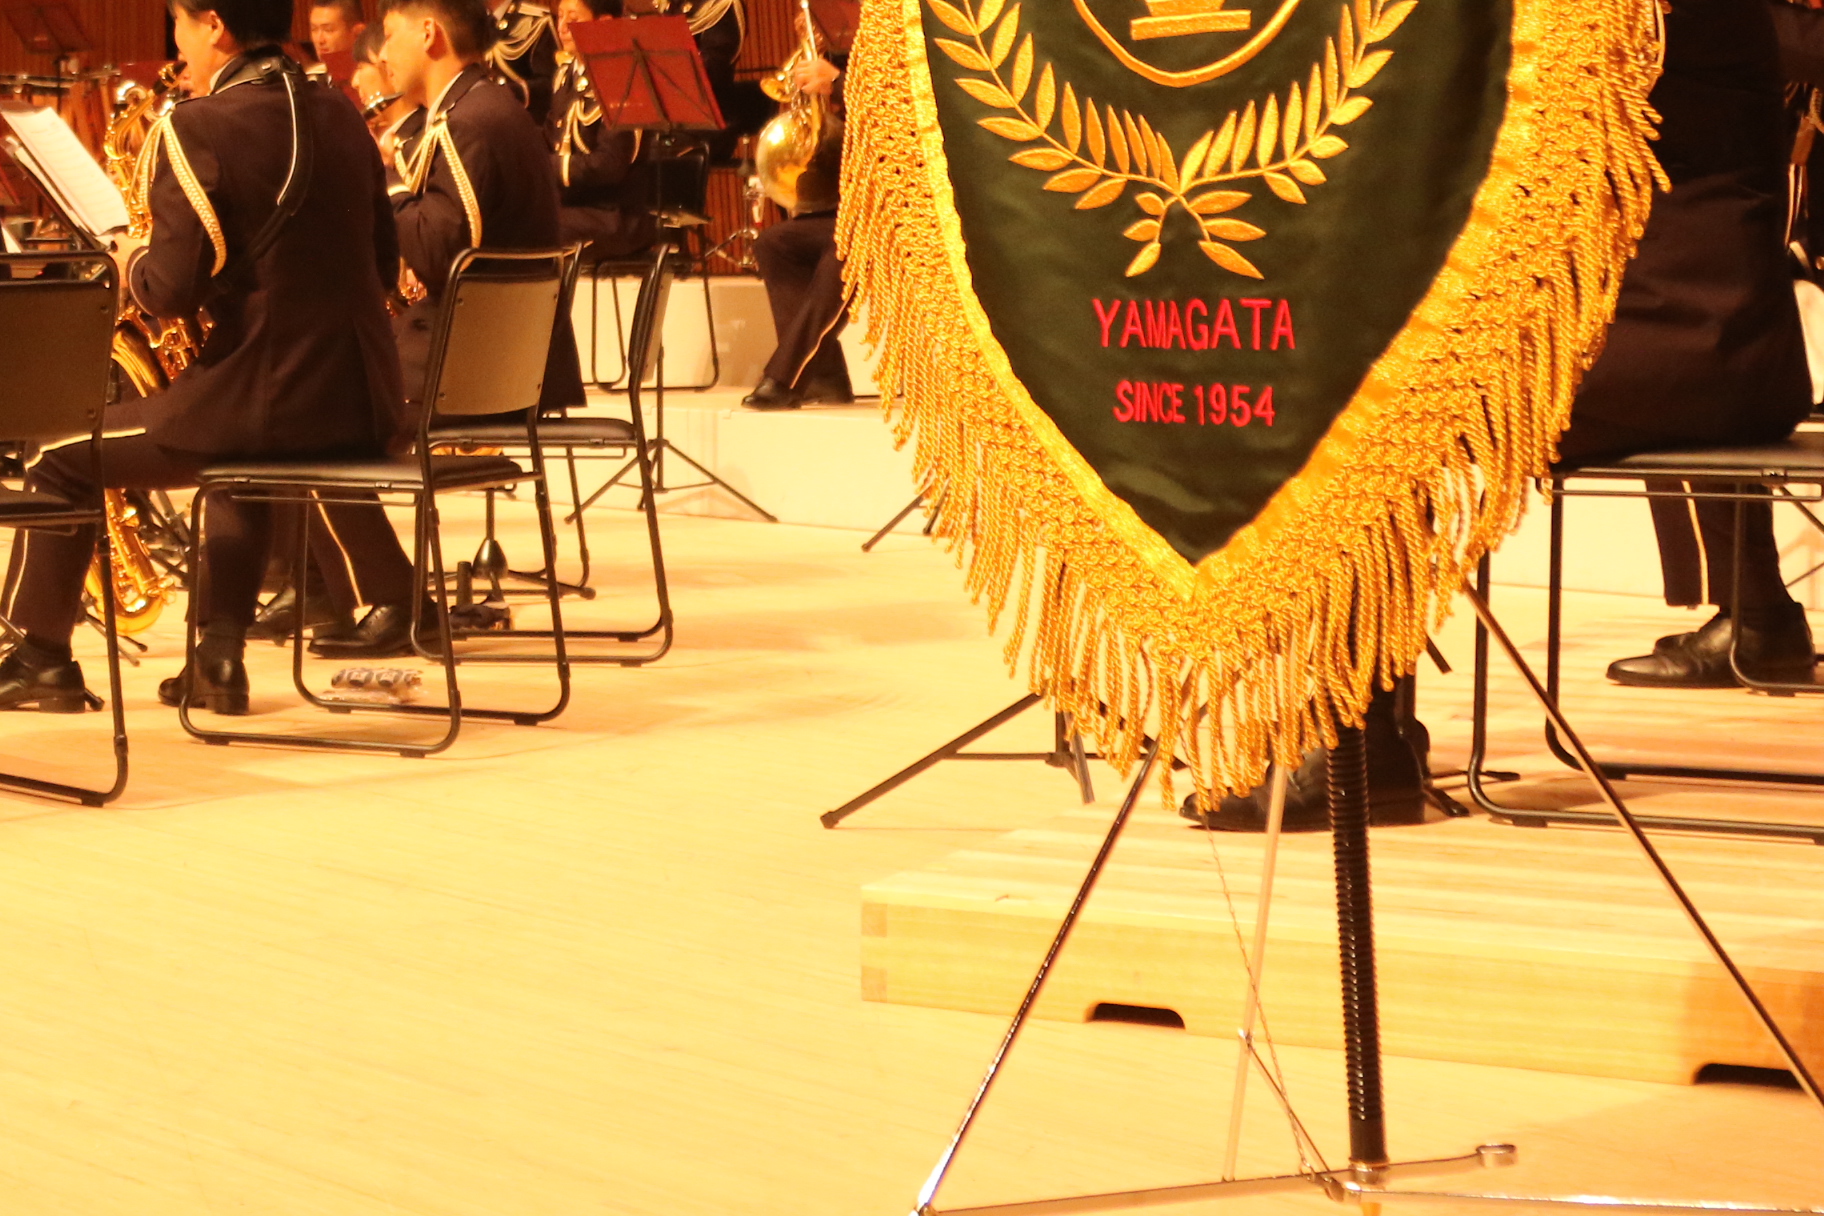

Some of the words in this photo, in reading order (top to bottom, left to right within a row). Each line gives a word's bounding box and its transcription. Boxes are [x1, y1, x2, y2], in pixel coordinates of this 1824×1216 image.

[1091, 297, 1296, 352] YAMAGATA
[1112, 378, 1187, 424] SINCE
[1193, 382, 1276, 428] 1954
